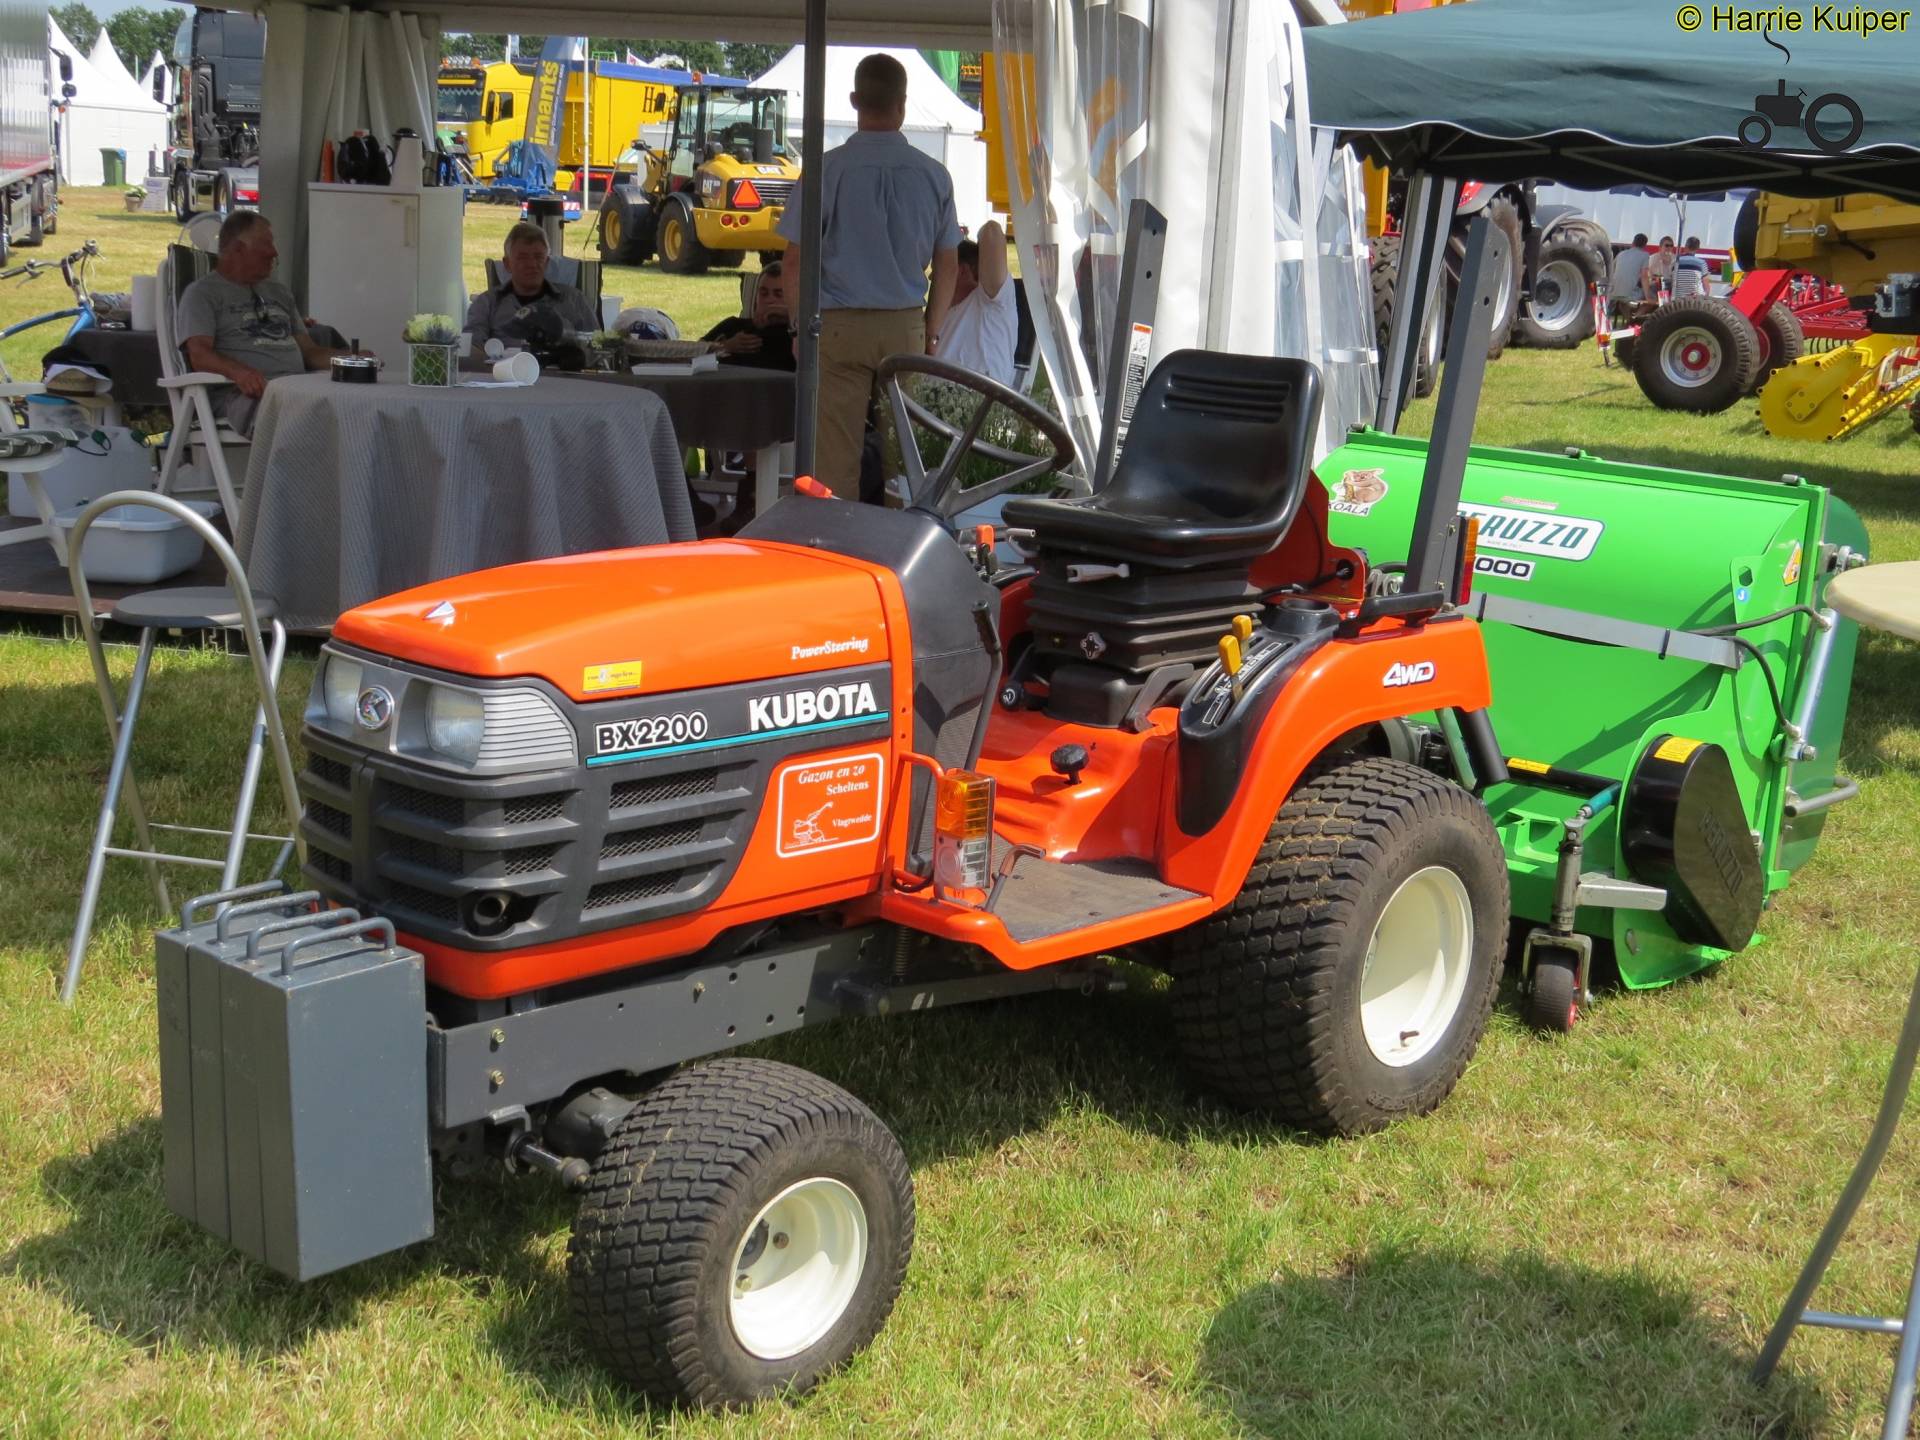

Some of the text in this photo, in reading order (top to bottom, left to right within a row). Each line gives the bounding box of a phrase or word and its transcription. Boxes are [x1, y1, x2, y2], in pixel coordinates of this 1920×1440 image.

[529, 61, 559, 145] imants
[702, 179, 713, 194] CAT
[1457, 509, 1589, 549] RUZZO
[791, 637, 869, 660] PowerSteering
[1383, 661, 1436, 688] 4WD
[749, 682, 877, 732] KUBOTA
[595, 711, 708, 754] BX2200
[798, 764, 865, 785] Gazon en zo
[825, 780, 869, 796] Scheltens
